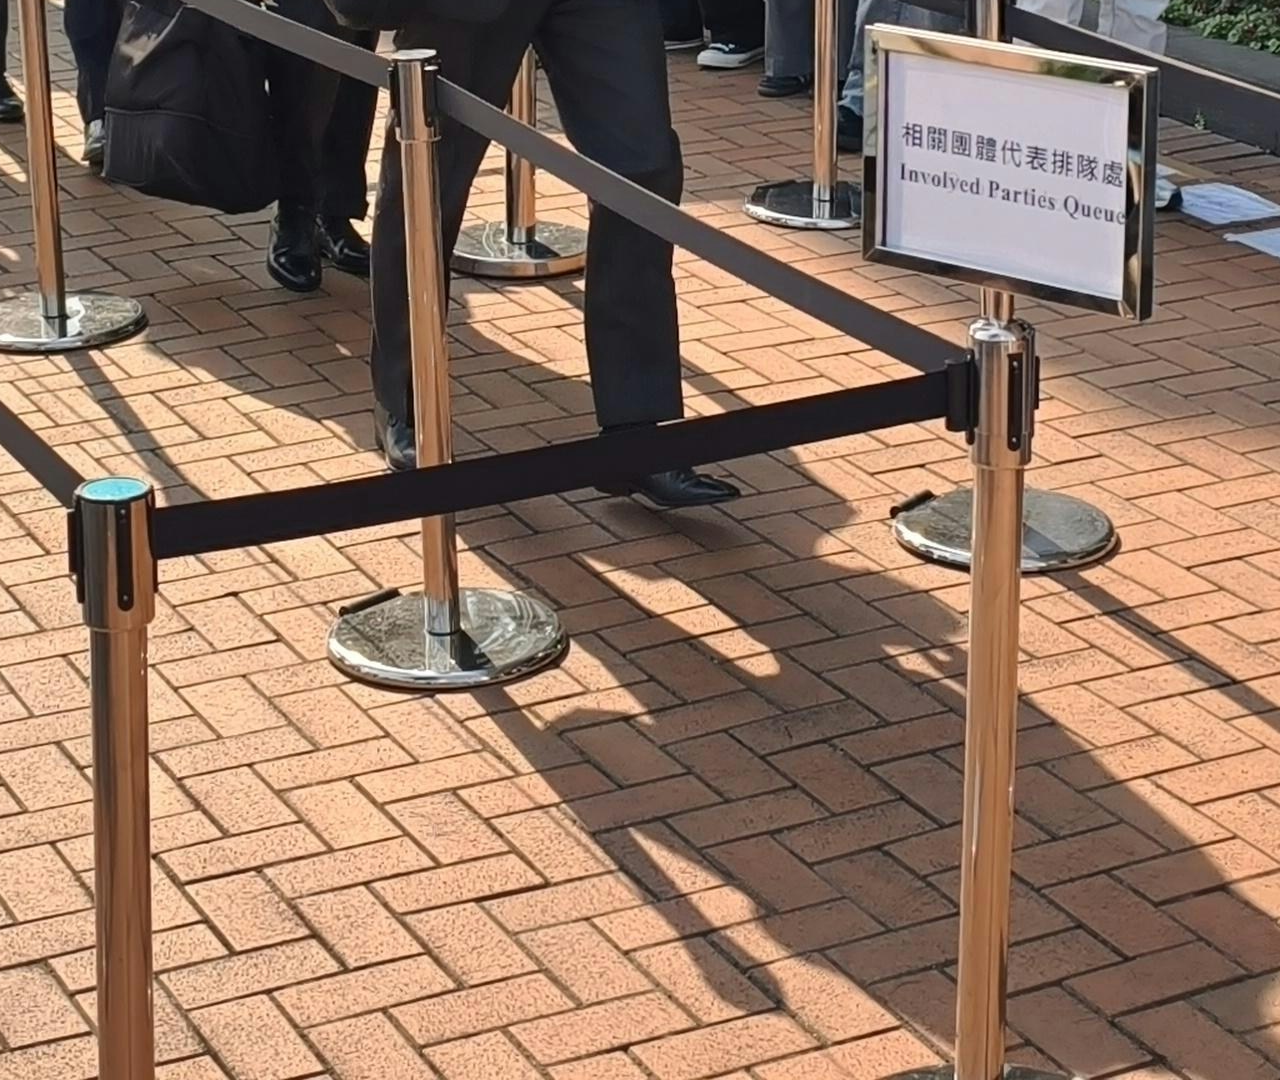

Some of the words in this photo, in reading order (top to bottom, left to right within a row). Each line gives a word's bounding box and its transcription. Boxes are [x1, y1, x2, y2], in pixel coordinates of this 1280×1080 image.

[901, 122, 1124, 188] 相關團體代表排隊處
[900, 162, 981, 195] Involved
[988, 180, 1056, 211] Parties
[1063, 194, 1126, 225] Queue
